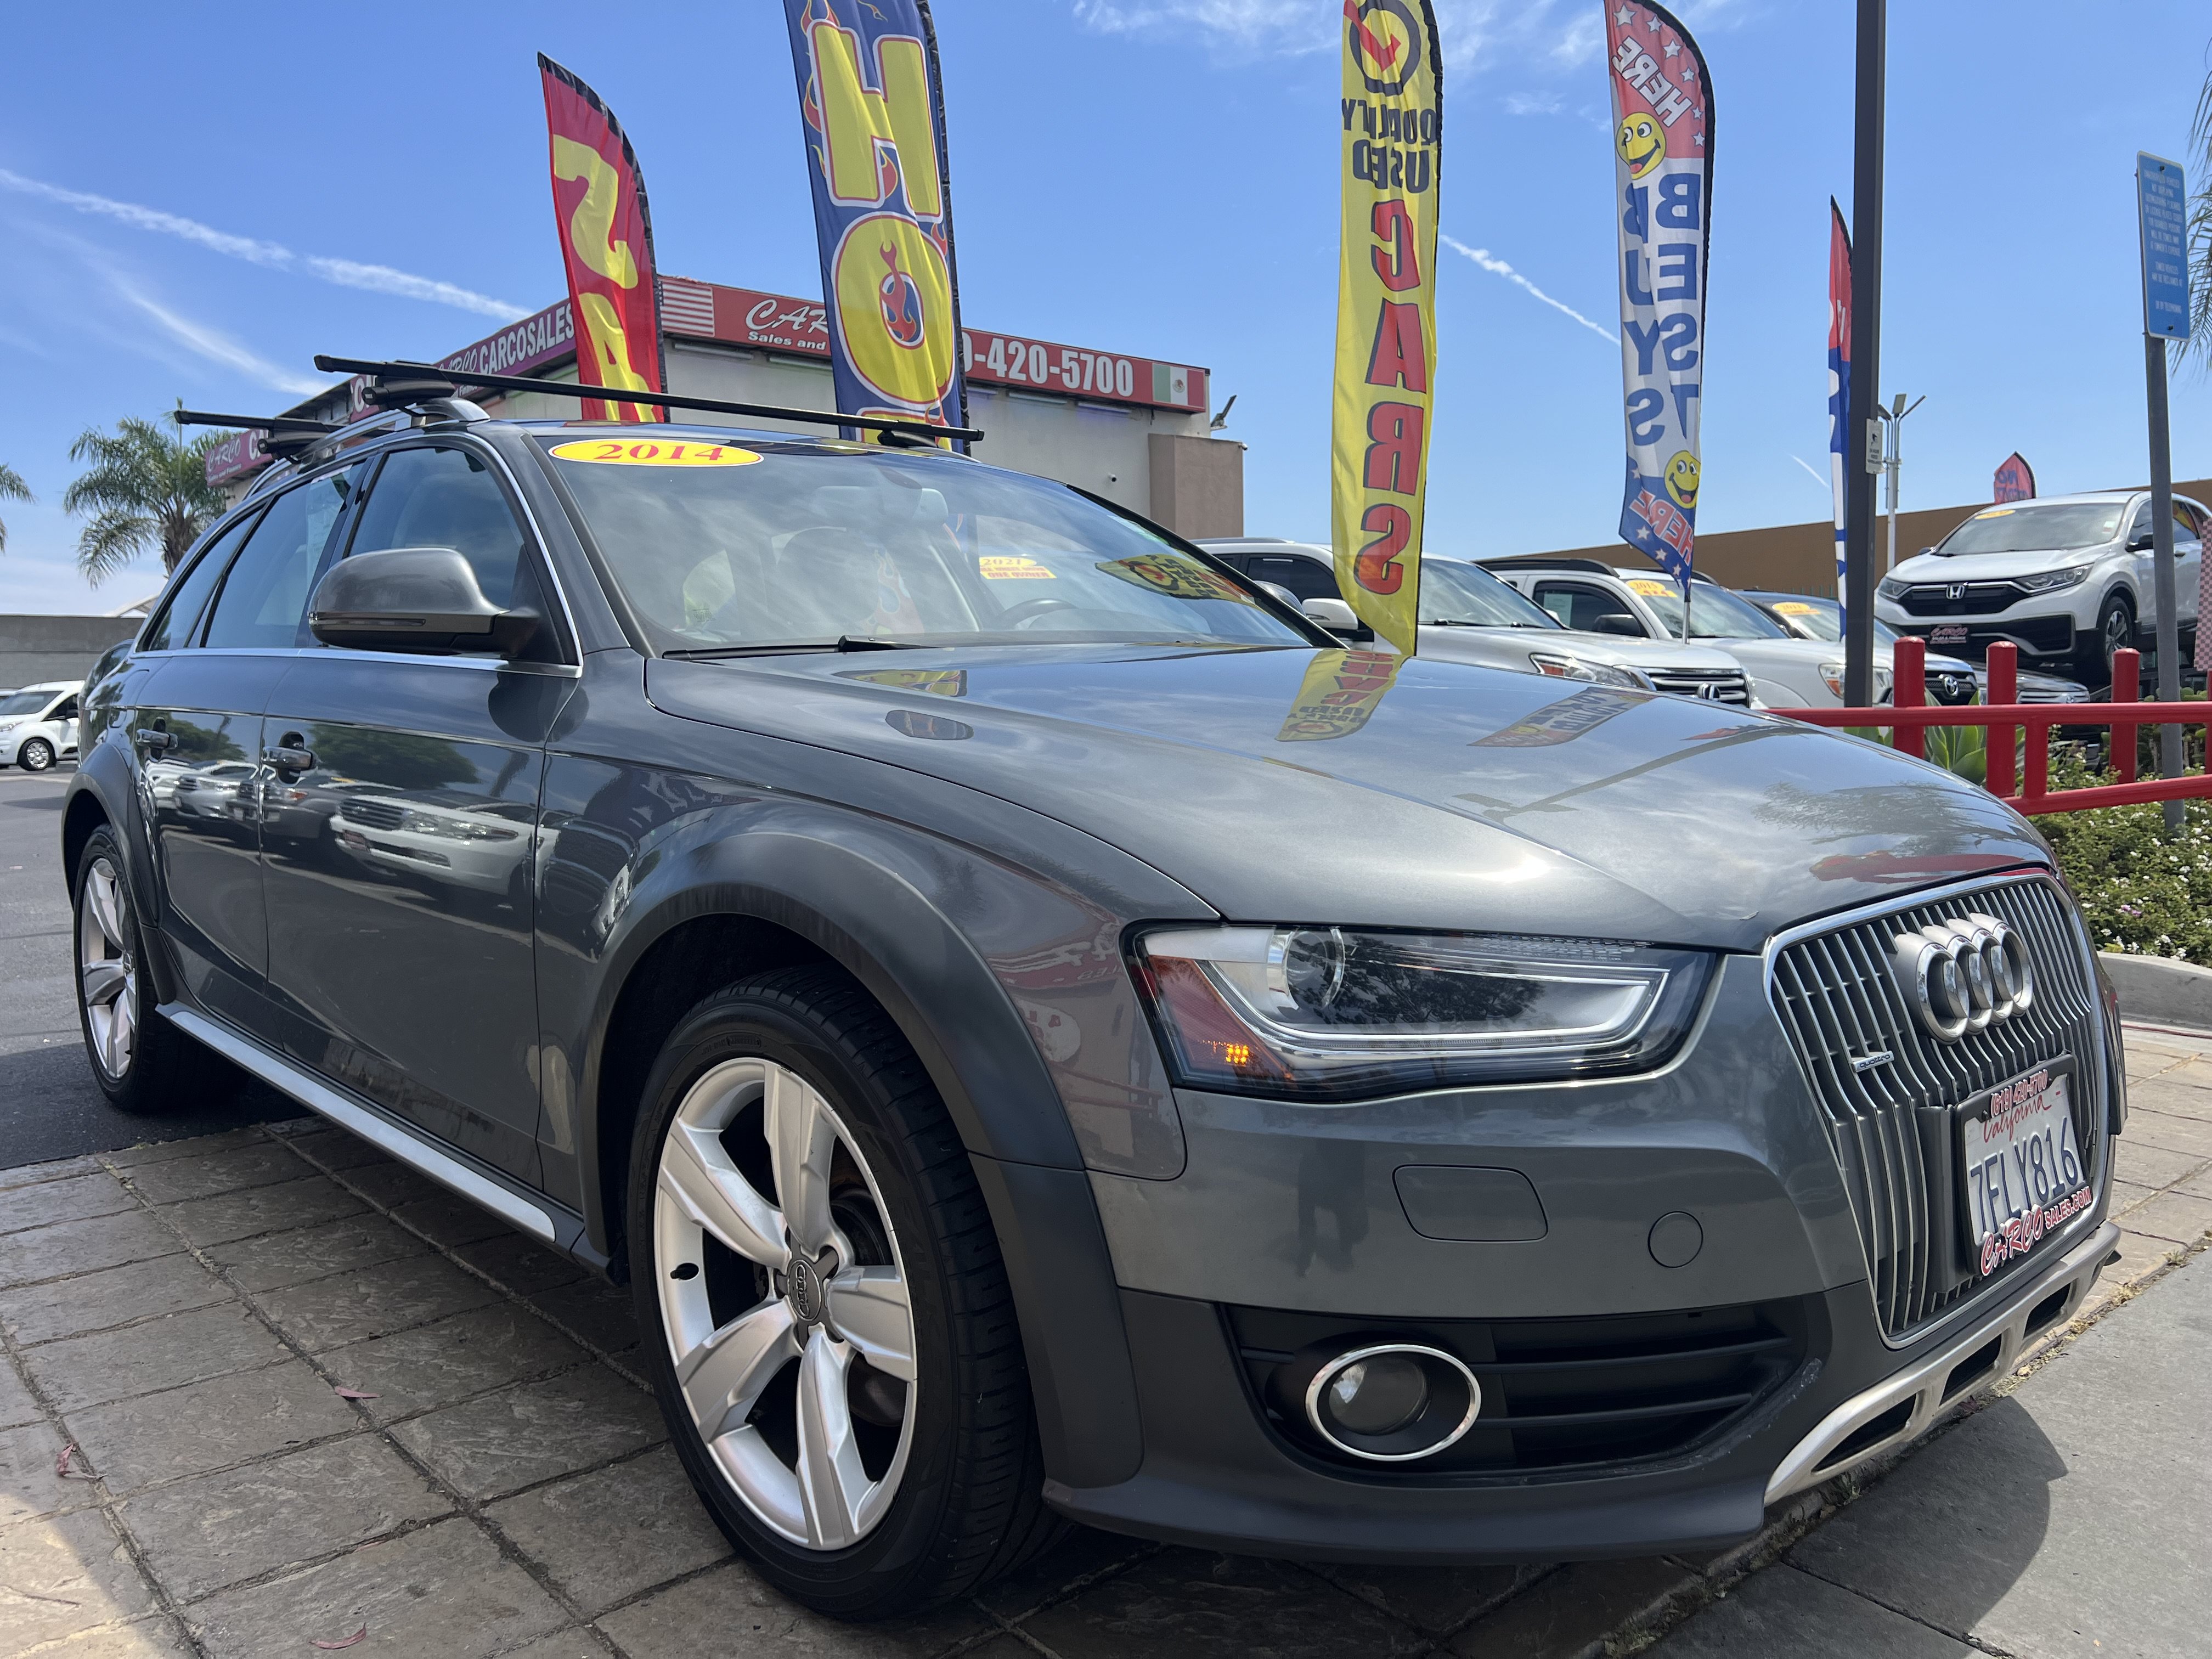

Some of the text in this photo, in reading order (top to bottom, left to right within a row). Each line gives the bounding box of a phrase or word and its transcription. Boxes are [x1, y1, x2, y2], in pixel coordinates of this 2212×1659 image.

[748, 330, 826, 351] Sales and
[208, 437, 241, 473] CARCO
[593, 444, 726, 461] 2014
[1859, 1054, 1891, 1068] quattro
[1990, 1069, 2049, 1119] (619) 420-5700
[1983, 1094, 2052, 1143] California
[1970, 1116, 2079, 1234] 7FLY816
[1980, 1186, 2093, 1276] CARCO SALES.COM
